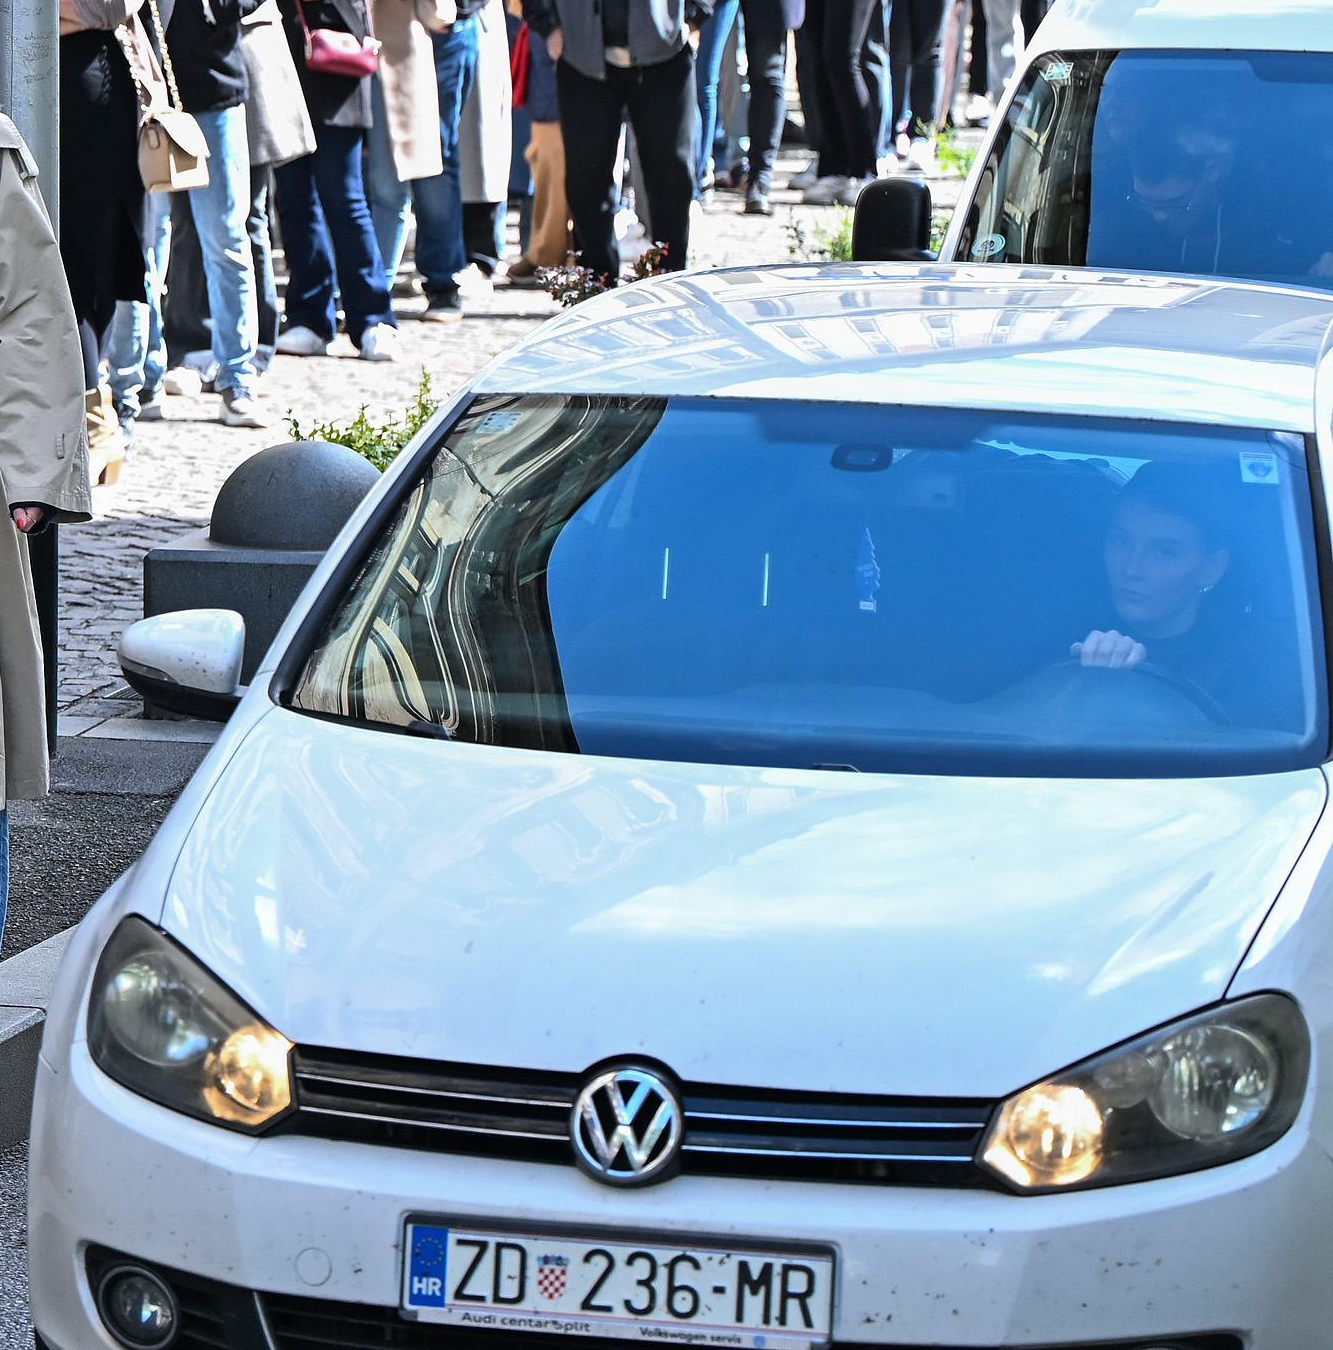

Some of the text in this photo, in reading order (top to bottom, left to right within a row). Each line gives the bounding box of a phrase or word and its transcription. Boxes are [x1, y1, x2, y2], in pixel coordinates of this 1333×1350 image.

[412, 1276, 442, 1298] HR
[453, 1238, 815, 1330] ZD 236-MR
[461, 1312, 496, 1325] Audi
[501, 1316, 550, 1329] centar
